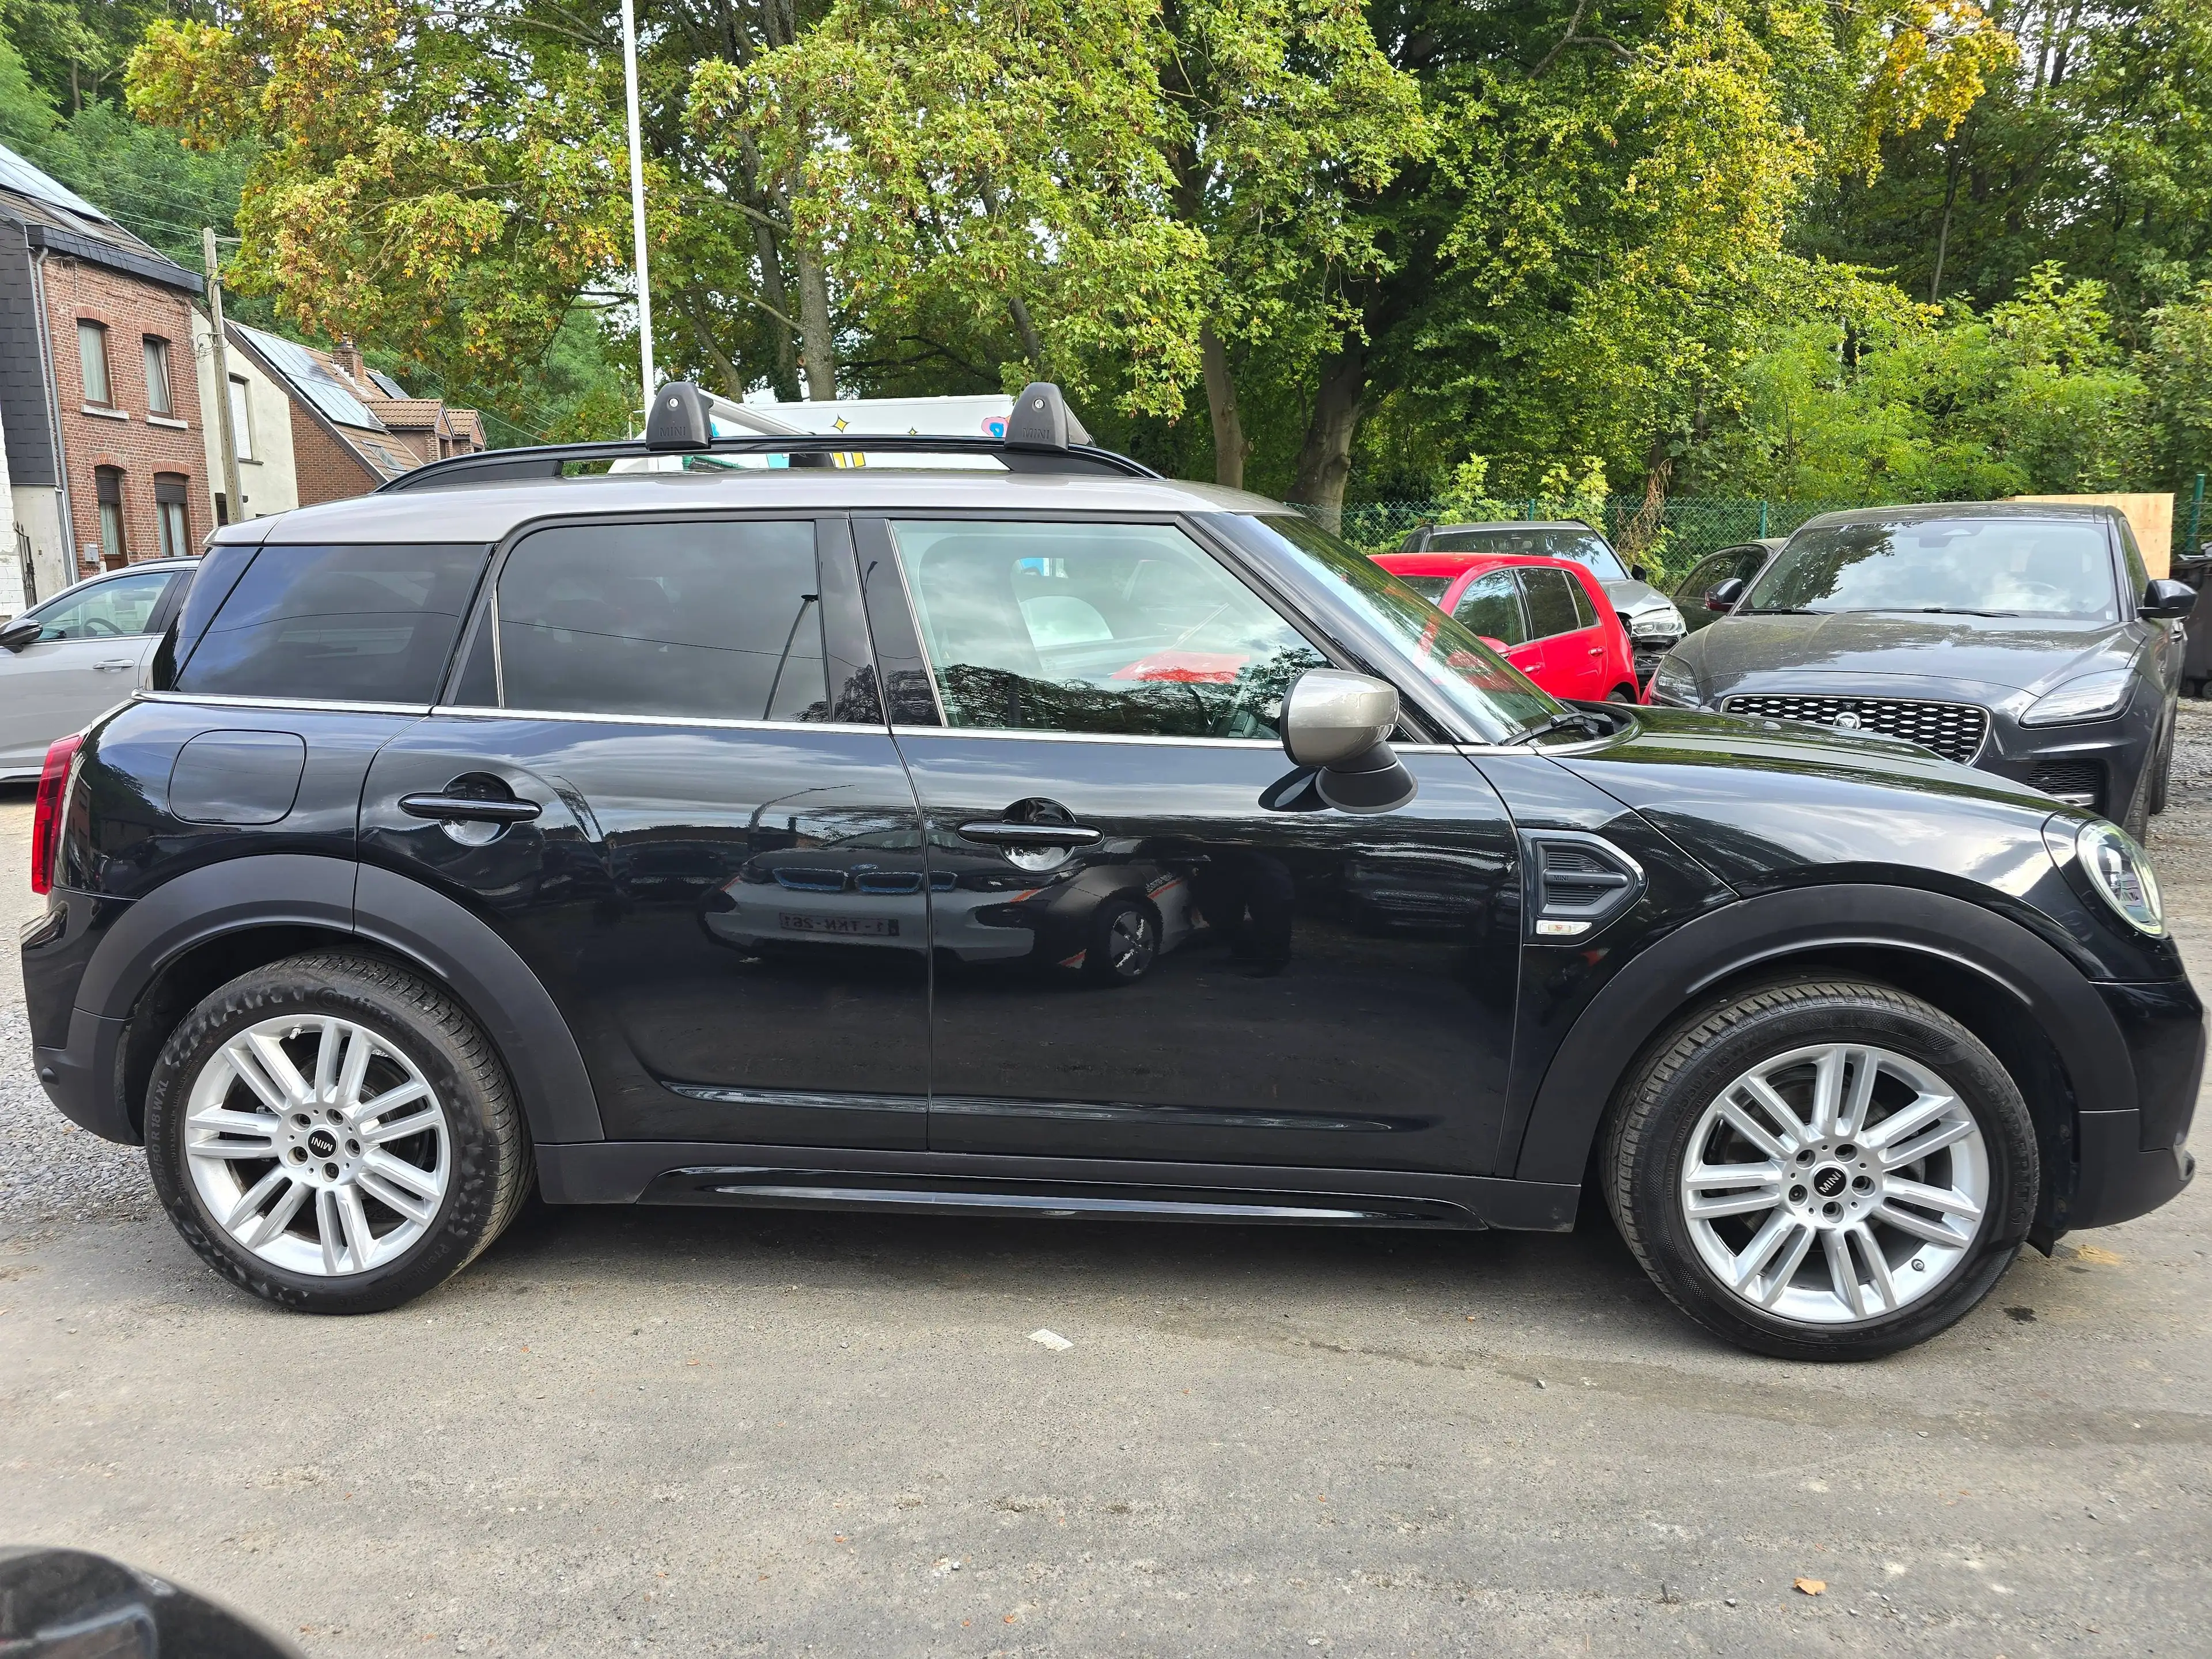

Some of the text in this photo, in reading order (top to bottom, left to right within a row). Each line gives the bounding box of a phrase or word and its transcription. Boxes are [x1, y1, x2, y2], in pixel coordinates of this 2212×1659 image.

[660, 427, 685, 437] MINI
[1023, 428, 1050, 438] MINI
[151, 1079, 171, 1192] 225/50 R 18 W XL
[311, 1137, 333, 1152] MINI
[1819, 1171, 1842, 1193] MINI
